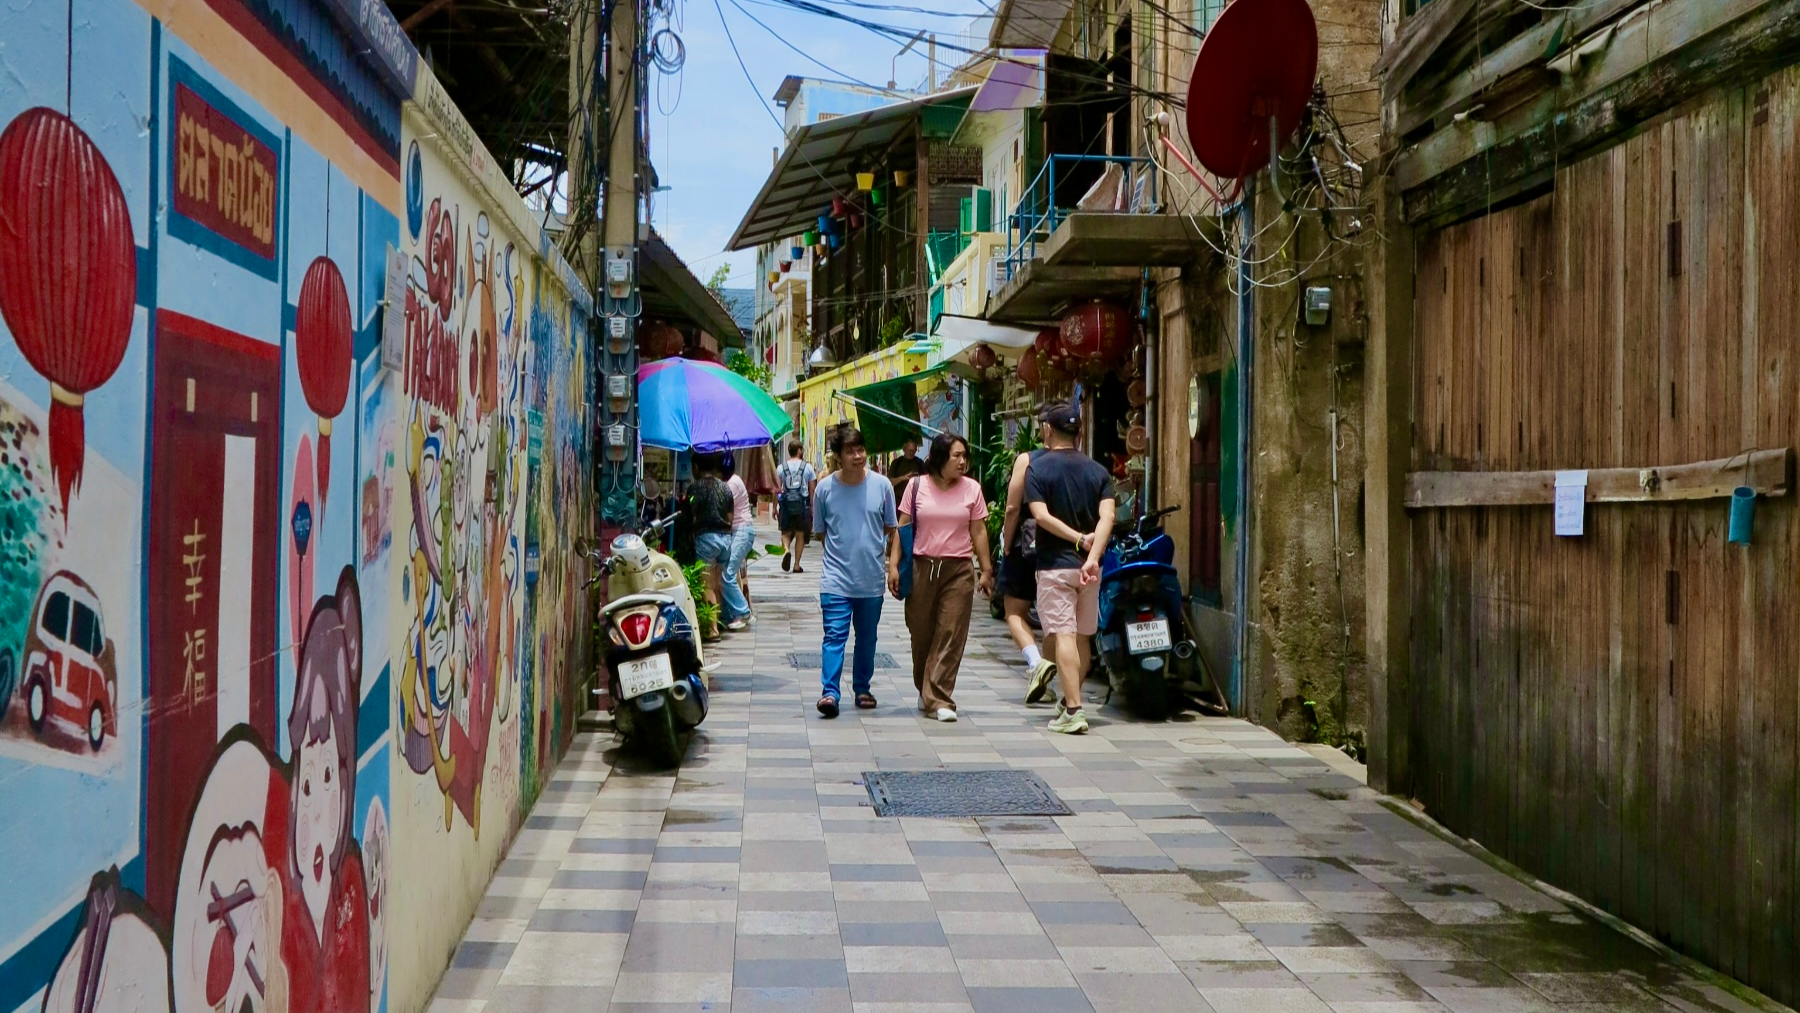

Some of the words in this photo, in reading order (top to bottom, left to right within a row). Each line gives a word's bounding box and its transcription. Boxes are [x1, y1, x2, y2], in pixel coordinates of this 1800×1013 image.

[179, 111, 274, 244] ตลาดน้อย
[1136, 639, 1164, 648] 4380
